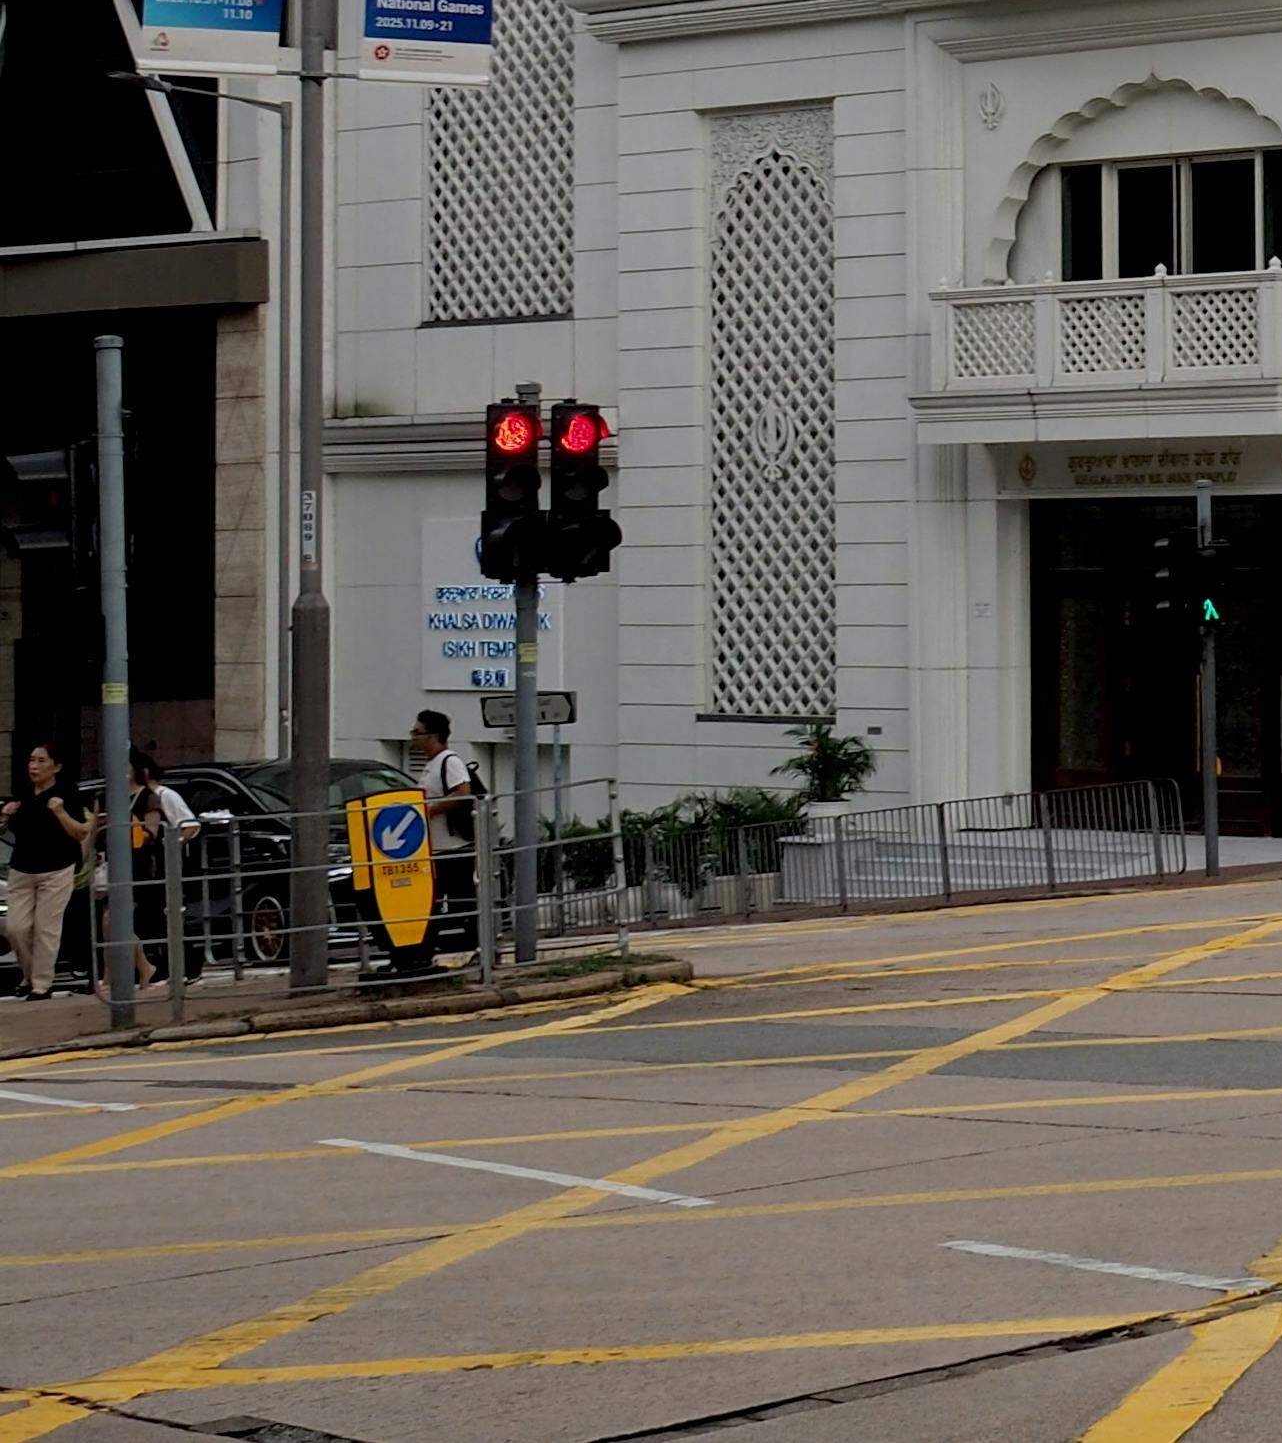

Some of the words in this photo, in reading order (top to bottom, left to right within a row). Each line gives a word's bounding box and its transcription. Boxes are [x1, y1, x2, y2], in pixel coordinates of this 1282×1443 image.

[223, 9, 253, 20] 11.10
[437, 0, 485, 15] Games
[428, 612, 481, 630] KHALSA
[482, 612, 517, 630] DIWA
